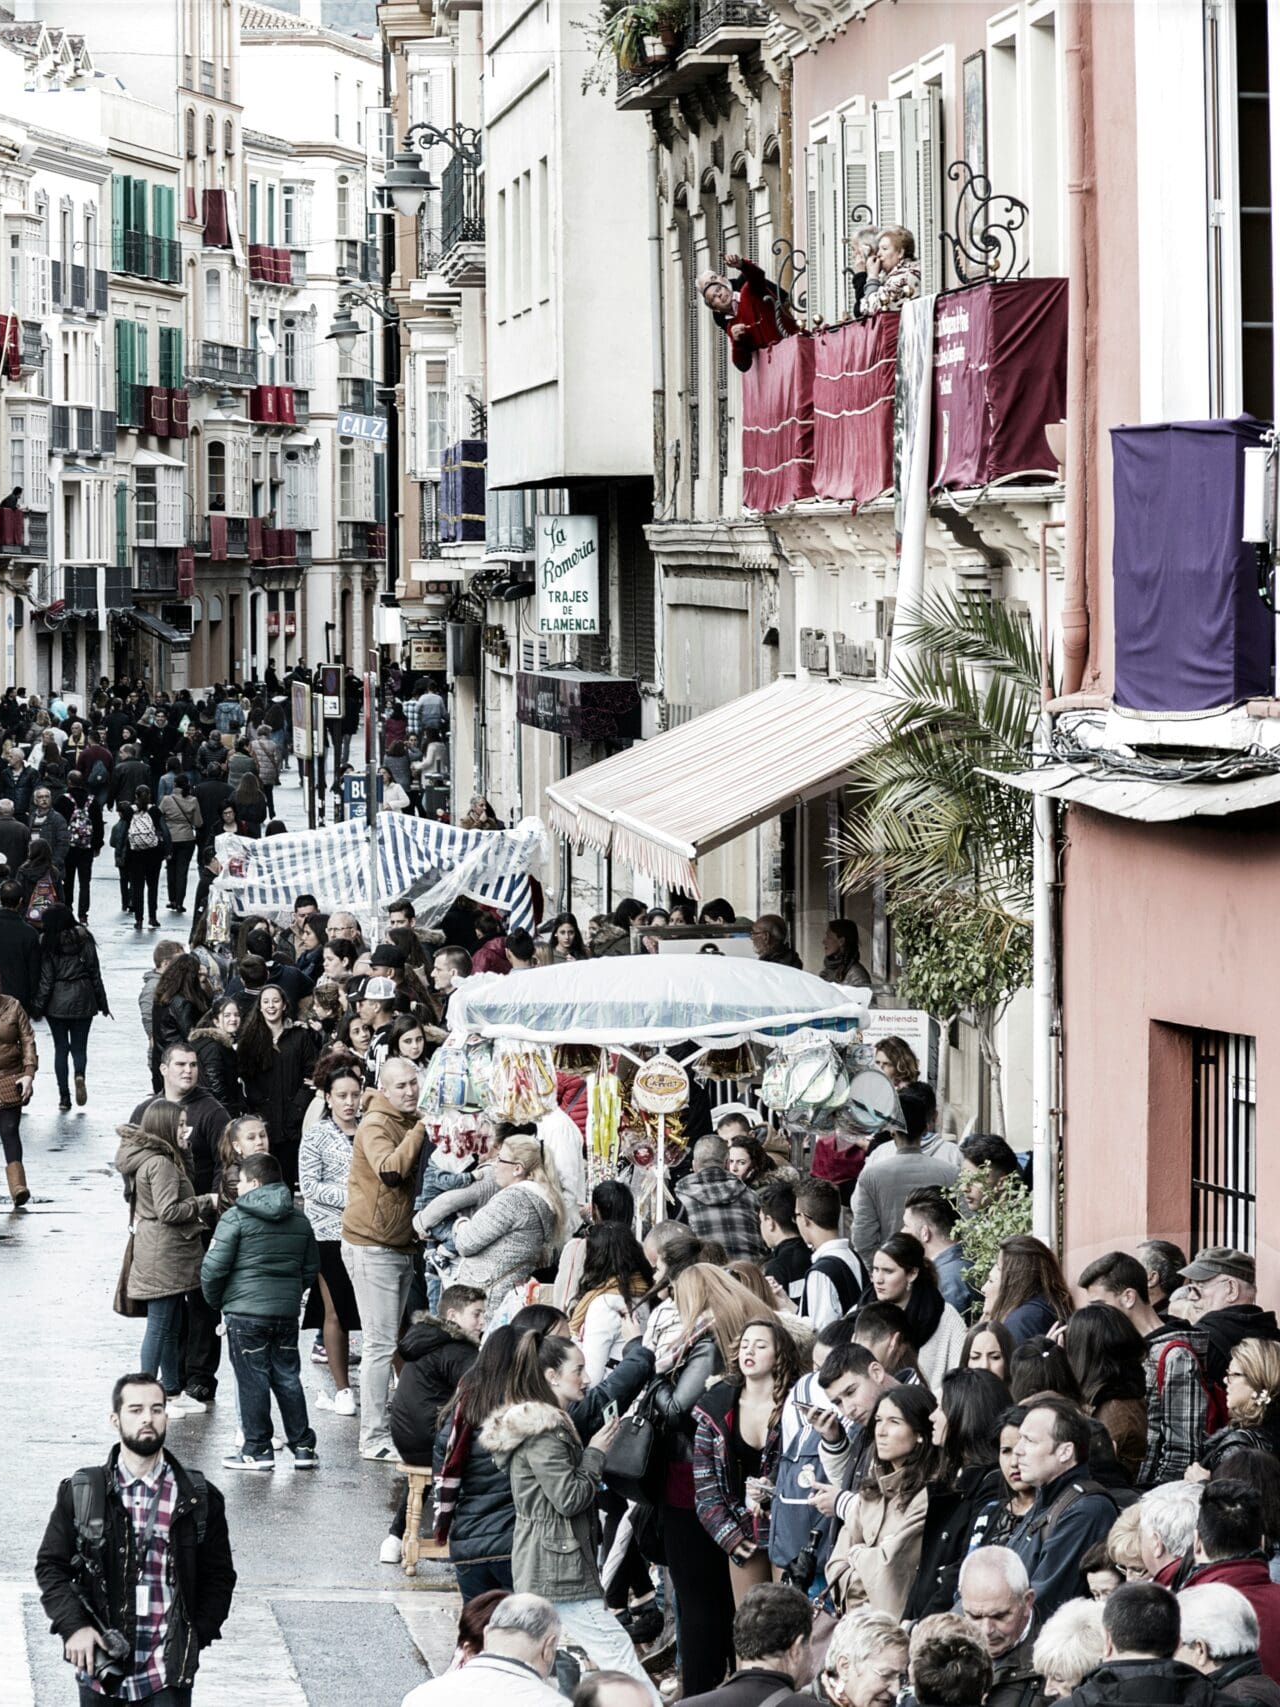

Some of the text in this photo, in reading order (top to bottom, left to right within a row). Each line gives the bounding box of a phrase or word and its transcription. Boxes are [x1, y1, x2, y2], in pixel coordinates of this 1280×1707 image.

[544, 519, 567, 554] La
[548, 590, 589, 603] TRAJES
[562, 605, 573, 615] DE
[540, 618, 596, 631] FLAMENCA
[879, 1014, 918, 1023] Merienda
